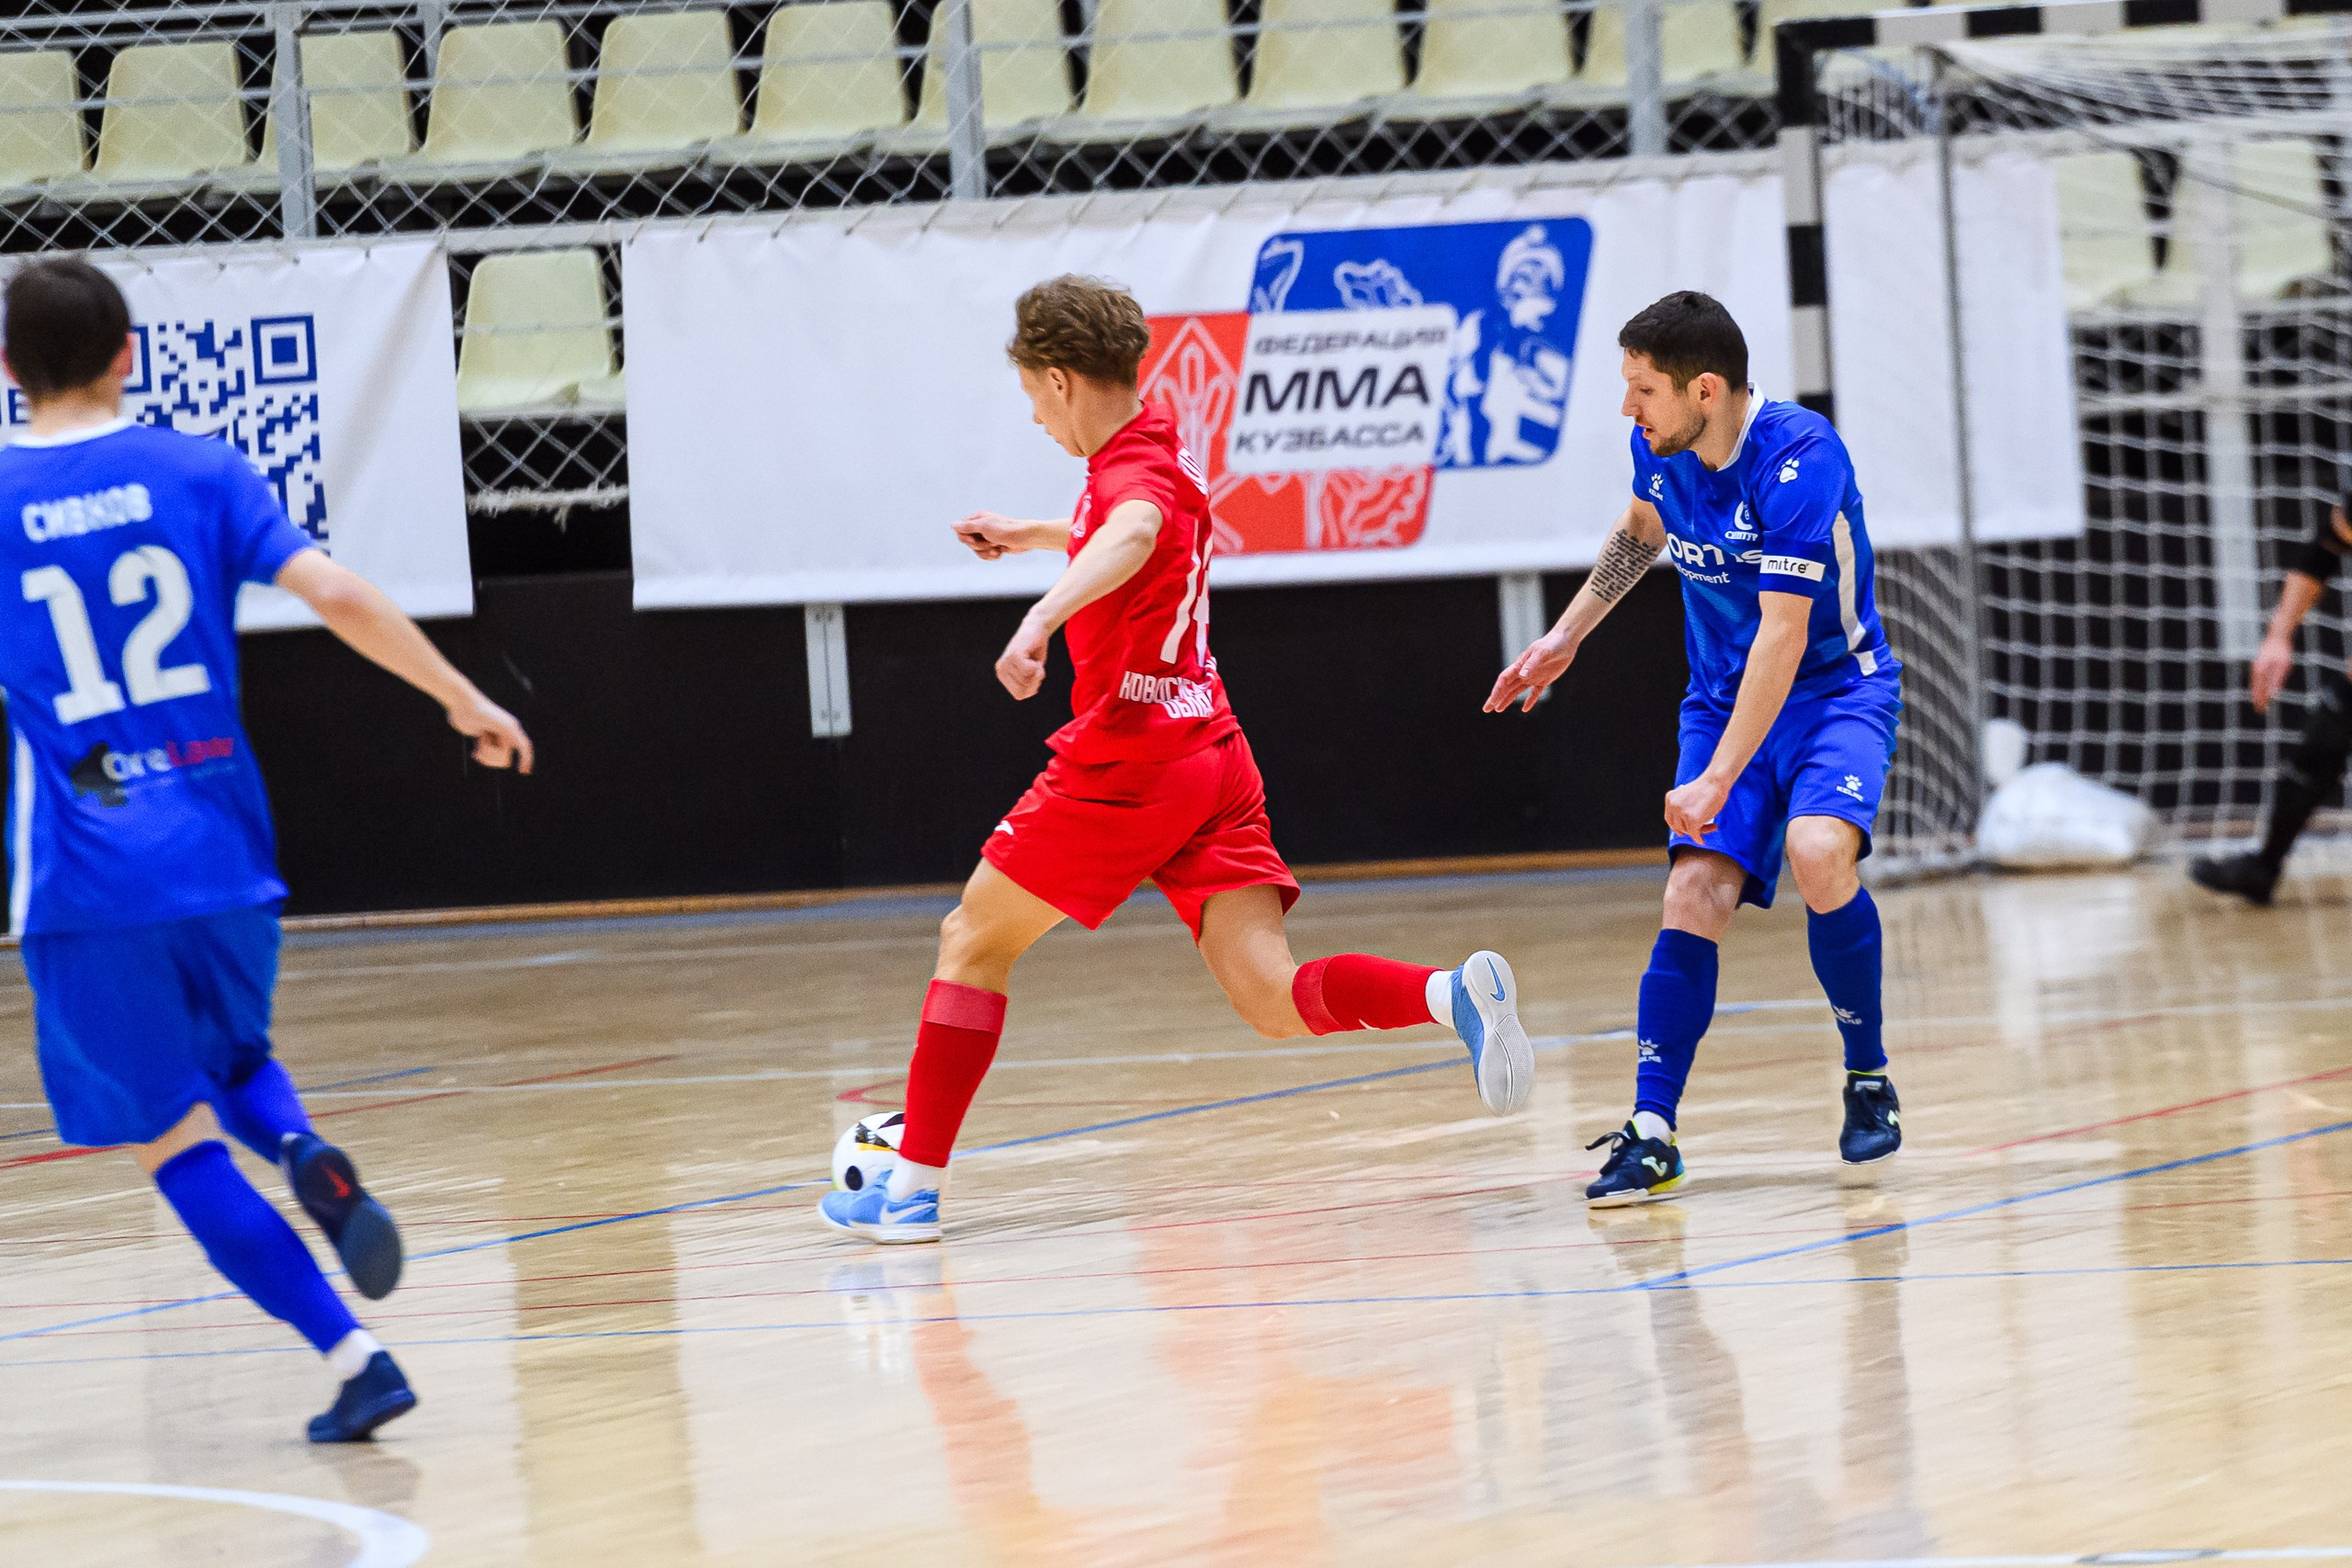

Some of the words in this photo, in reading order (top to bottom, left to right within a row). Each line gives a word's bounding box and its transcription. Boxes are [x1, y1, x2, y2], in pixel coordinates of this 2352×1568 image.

[1253, 324, 1449, 355] ФЕДЕРАЦИЯ
[1244, 364, 1430, 414] ММА
[1235, 421, 1425, 454] КУЗБАССА
[1767, 558, 1807, 574] mitre
[21, 545, 211, 726] 12
